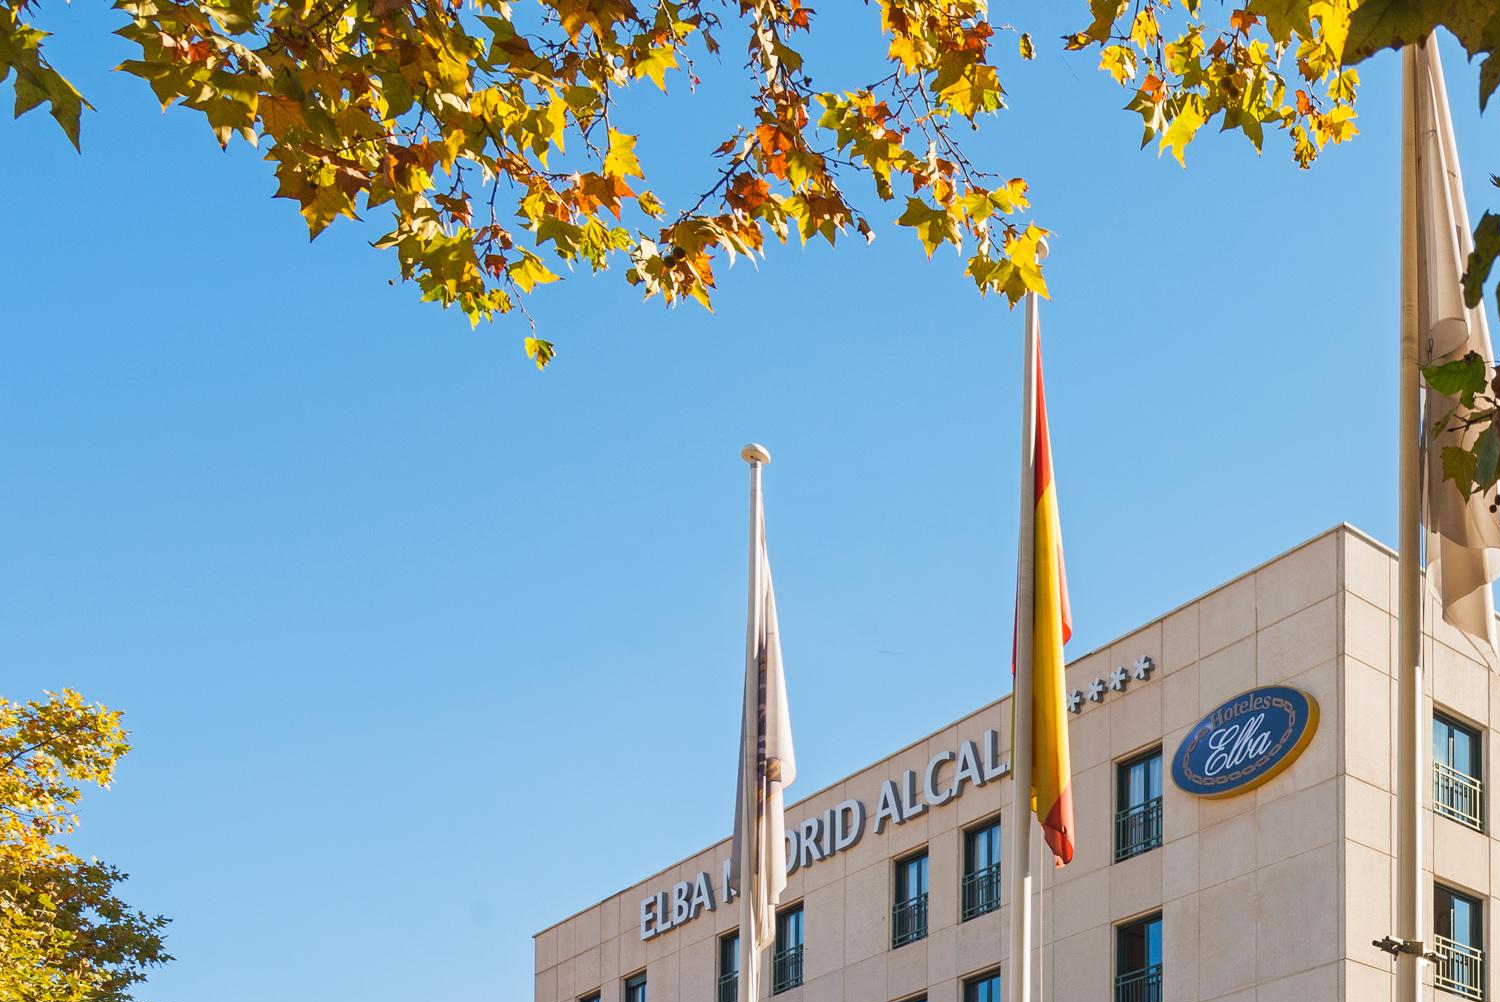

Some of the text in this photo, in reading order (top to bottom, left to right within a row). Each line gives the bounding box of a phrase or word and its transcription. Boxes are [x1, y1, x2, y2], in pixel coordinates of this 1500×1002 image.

[1209, 693, 1272, 730] Hoteles
[1204, 712, 1272, 776] Elba
[639, 728, 1010, 942] ELBA DRID ALCAL
